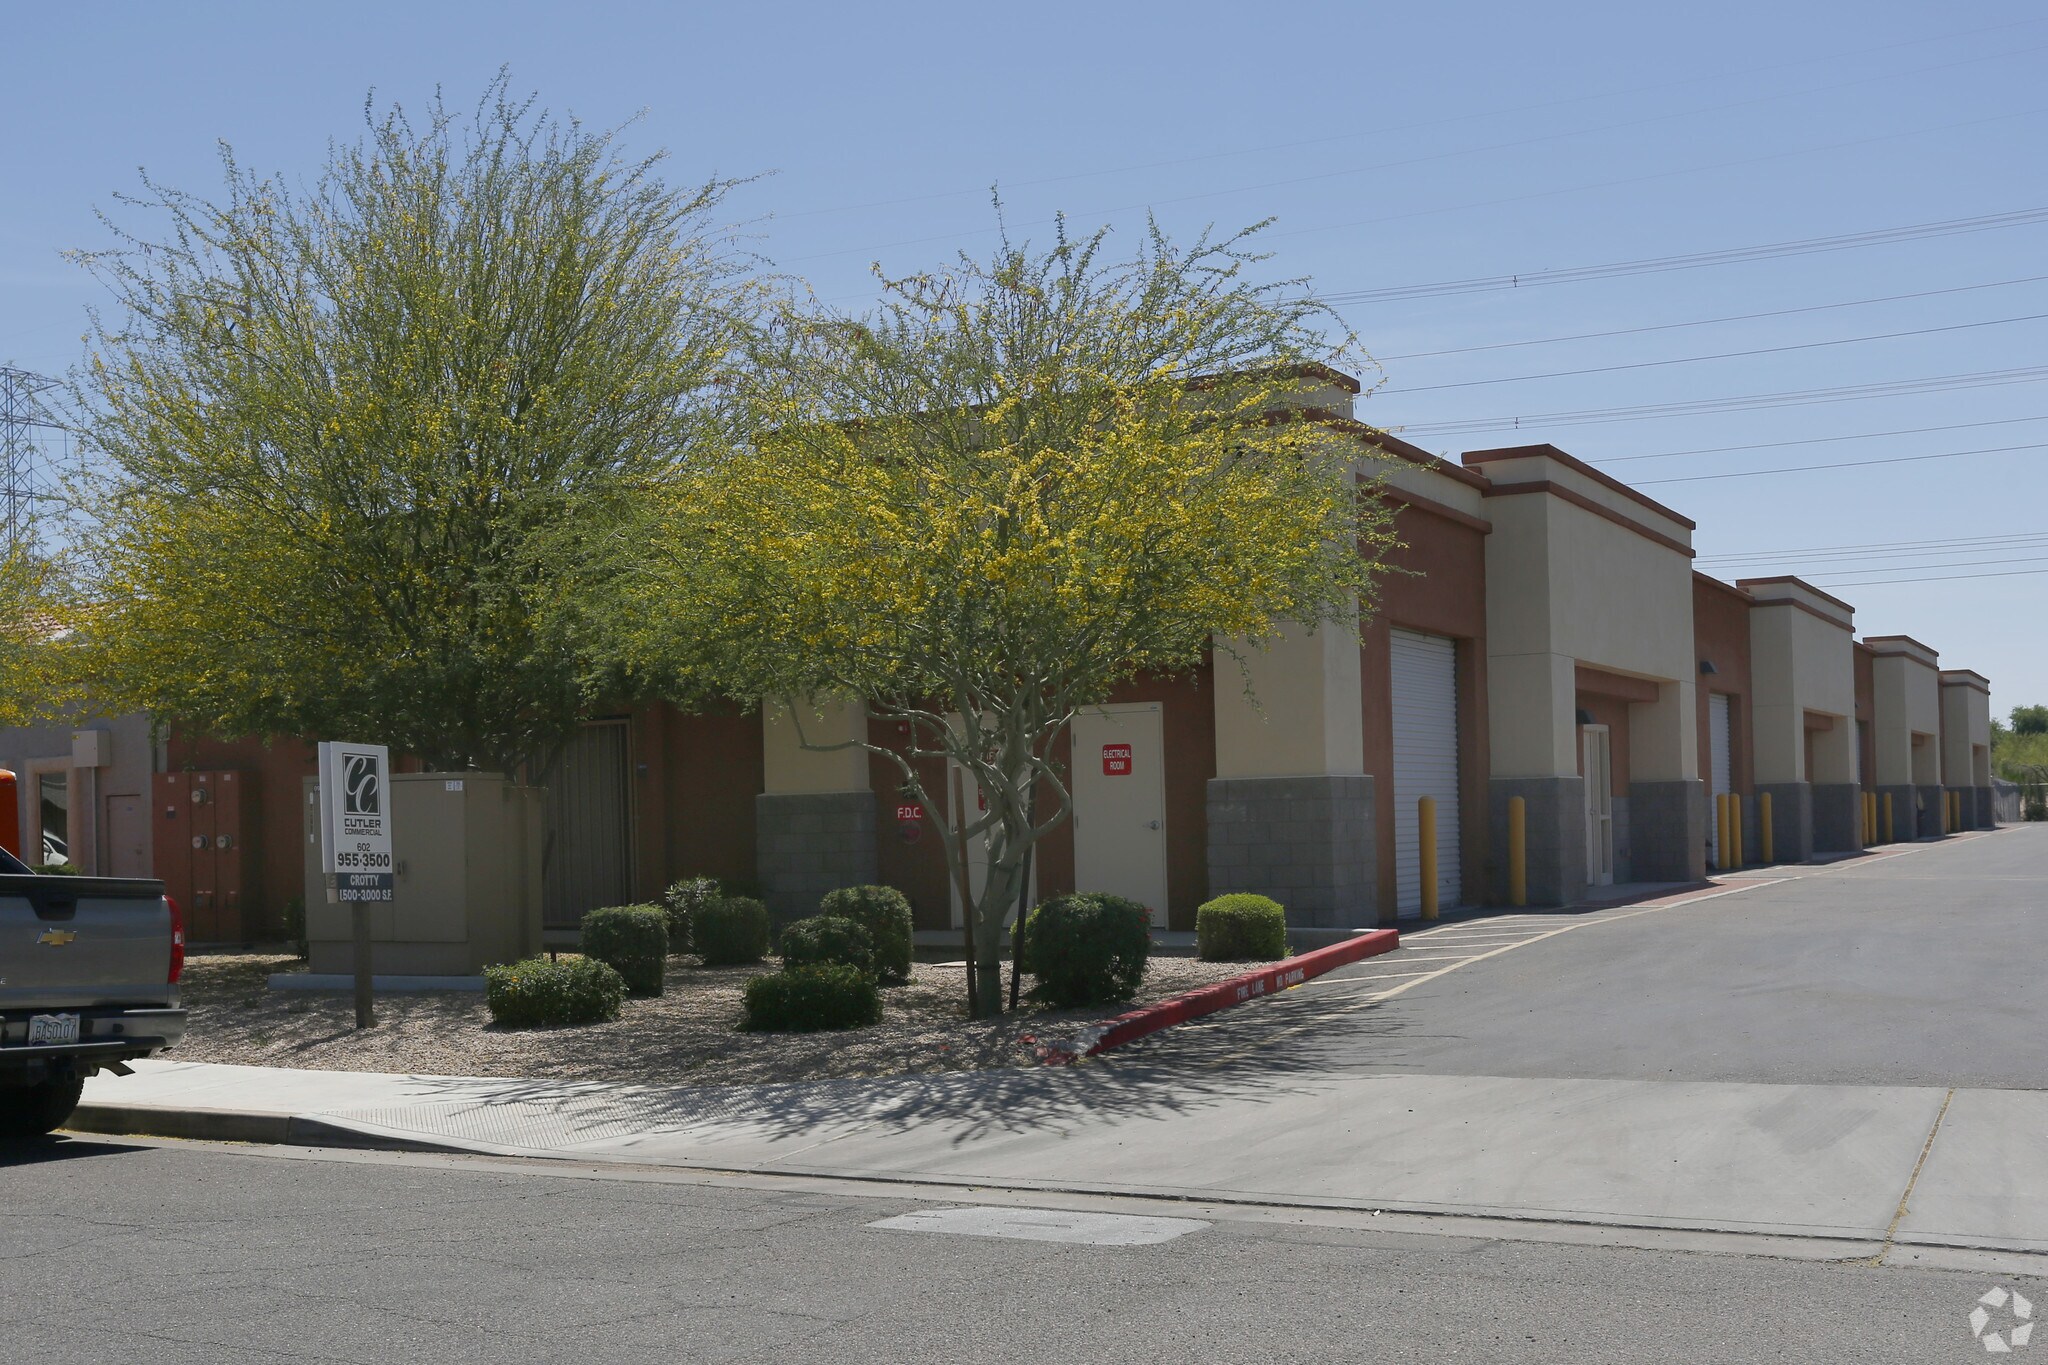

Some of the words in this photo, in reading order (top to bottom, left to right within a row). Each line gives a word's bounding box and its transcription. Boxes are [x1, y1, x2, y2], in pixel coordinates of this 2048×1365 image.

[1103, 747, 1131, 758] ELECTRICAL
[1109, 761, 1125, 770] ROOM
[897, 807, 922, 819] F.D.C.
[344, 818, 381, 828] CUTLER
[344, 828, 382, 836] COMMERCIAL
[356, 843, 371, 852] 602
[350, 874, 379, 886] CROTTY
[1237, 984, 1249, 1000] FIRE
[1252, 979, 1264, 994] LANE
[1276, 975, 1283, 989] NO
[1285, 968, 1304, 984] PARKING
